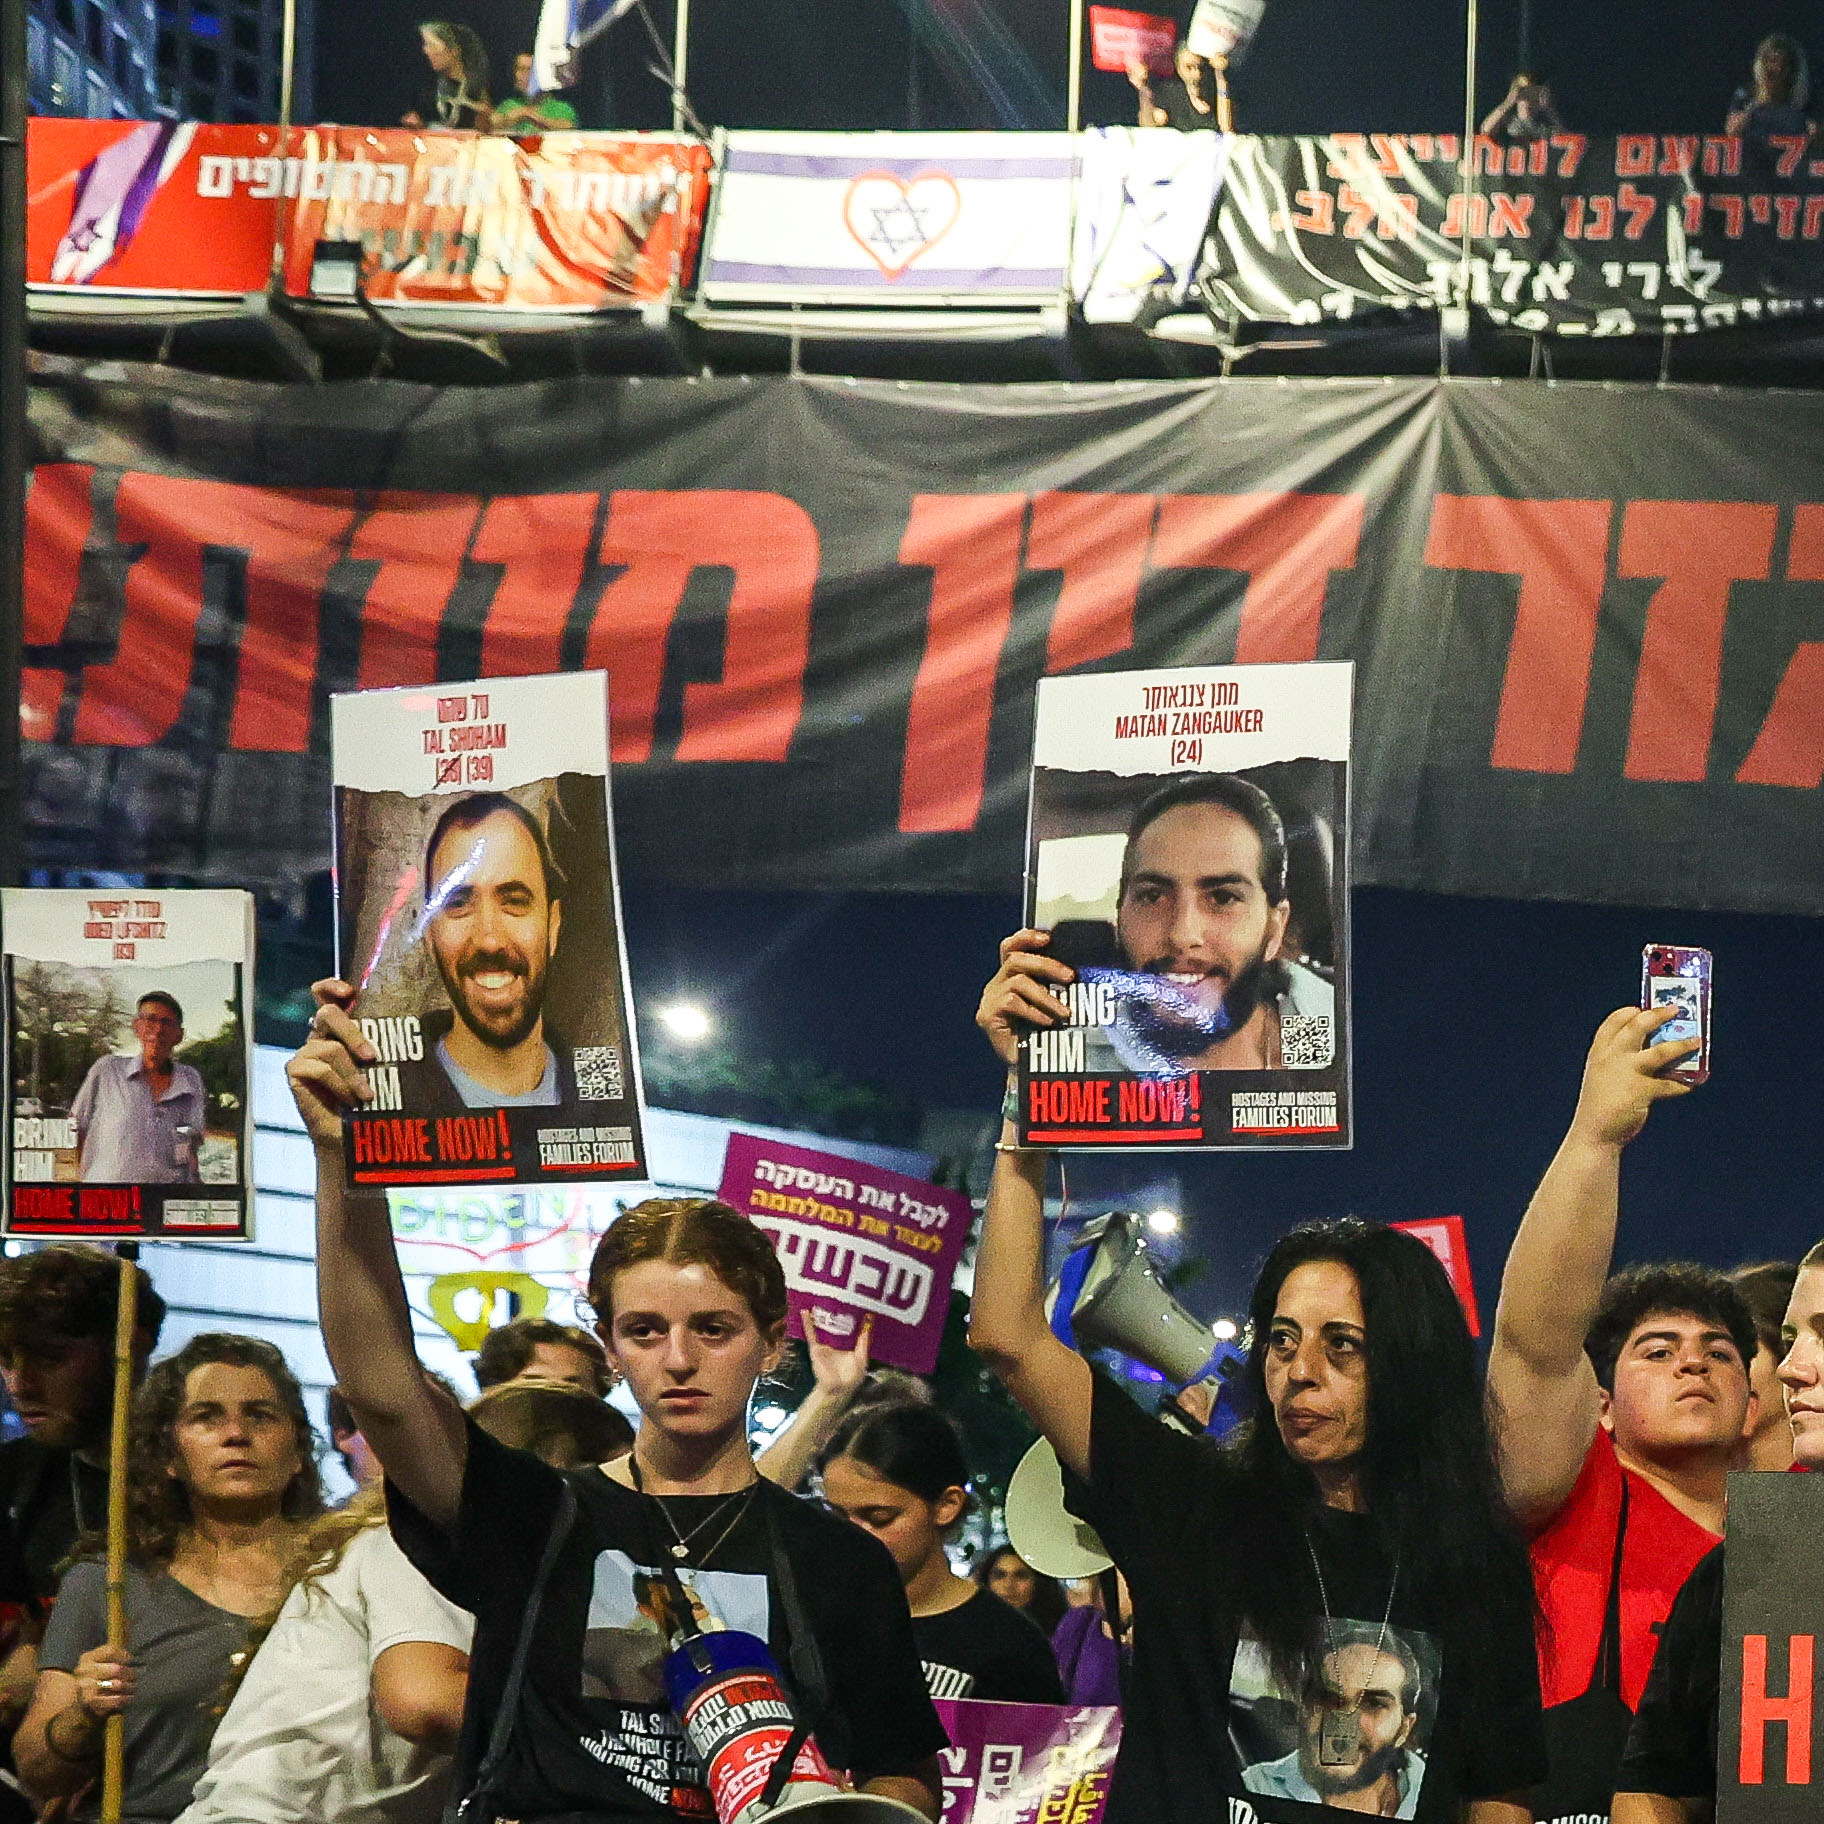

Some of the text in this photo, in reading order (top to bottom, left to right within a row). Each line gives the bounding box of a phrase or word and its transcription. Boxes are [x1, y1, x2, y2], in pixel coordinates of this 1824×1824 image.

[1616, 132, 1738, 179] העם
[1440, 193, 1536, 240] את
[1562, 183, 1657, 241] לנו
[22, 462, 822, 763] מוות!
[897, 493, 1366, 833] דין
[1141, 682, 1239, 711] מתן צנגאוקר
[422, 728, 445, 754] TAL
[1115, 709, 1263, 740] MATAN ZANGAUKER
[466, 752, 493, 785] (39)
[1170, 738, 1203, 767] (24)
[352, 1015, 424, 1063] RING
[1029, 1031, 1086, 1073] HIM
[1029, 1072, 1202, 1124] HOME NOW!
[1232, 1105, 1338, 1128] FAMILIES FORUM
[353, 1109, 513, 1164] HOME NOW!
[749, 1187, 855, 1227] המלחמה
[753, 1158, 950, 1229] לקבל את העסקה
[619, 1709, 650, 1734] TAL
